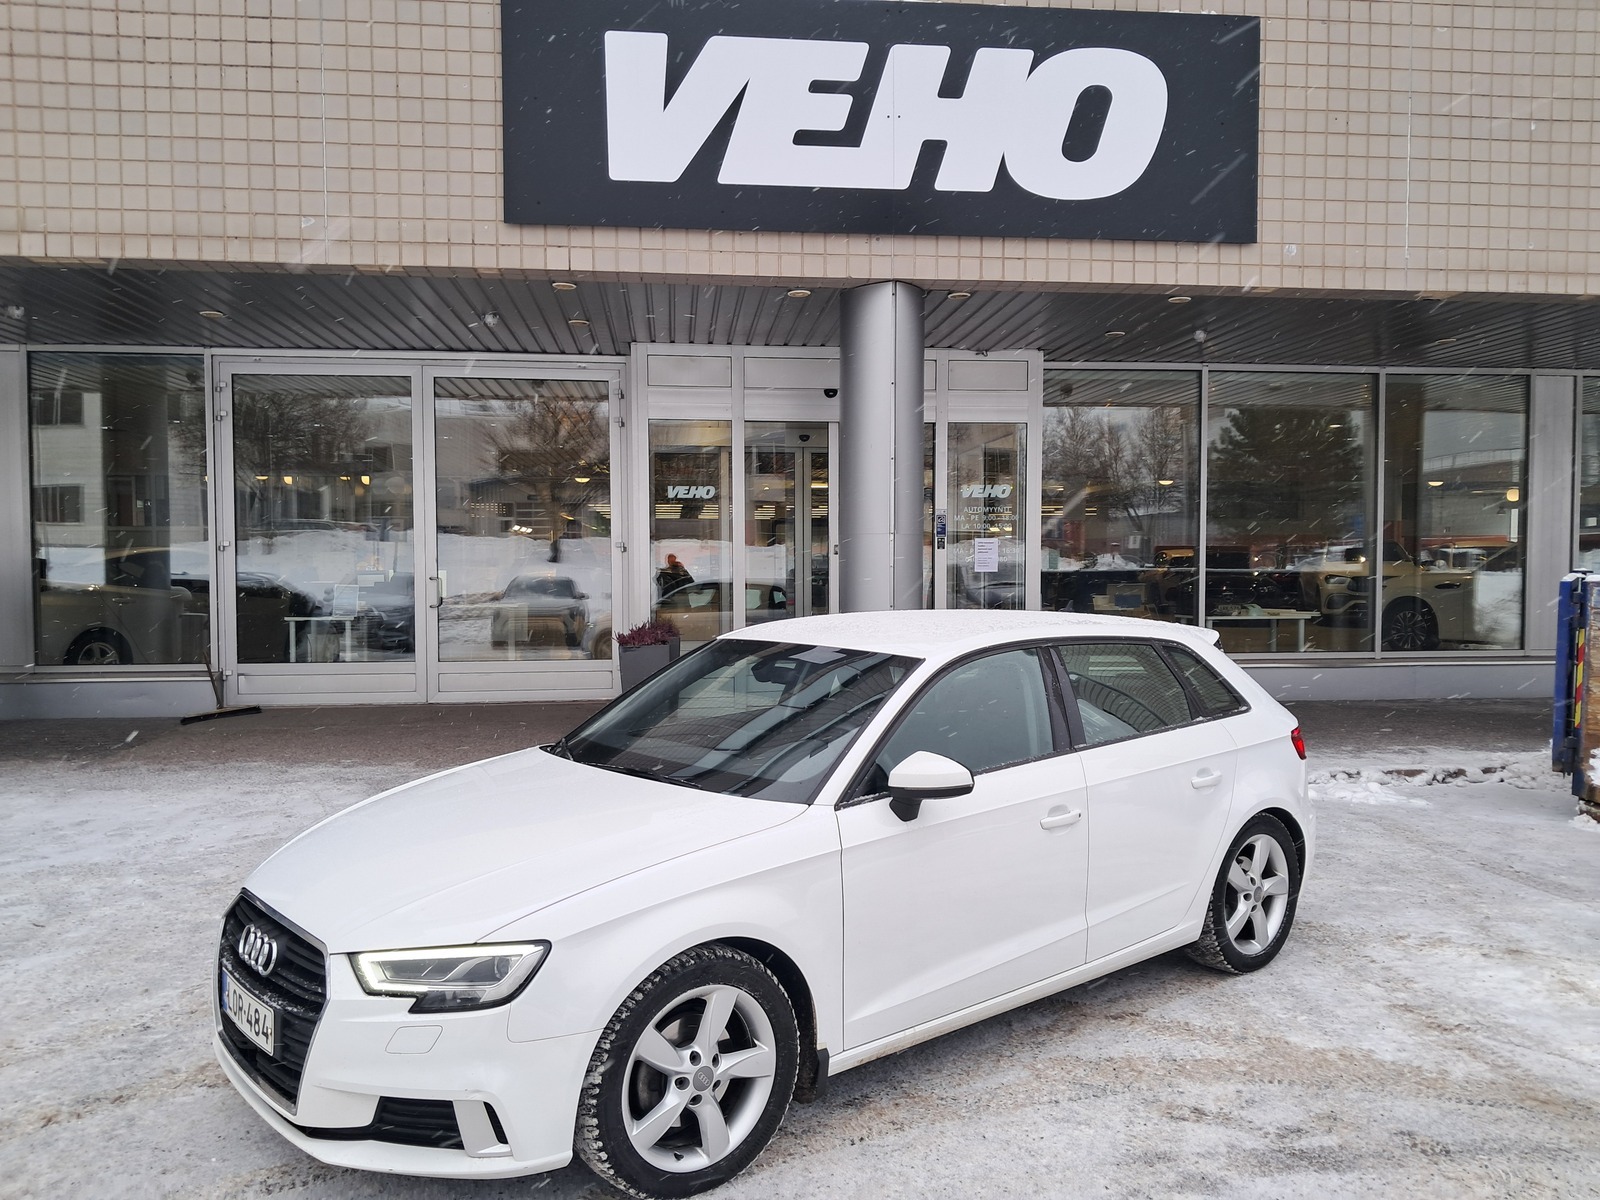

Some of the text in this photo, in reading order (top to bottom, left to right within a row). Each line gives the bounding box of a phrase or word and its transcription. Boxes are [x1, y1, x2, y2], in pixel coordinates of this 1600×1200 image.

[604, 31, 1168, 200] VEHO
[667, 485, 716, 499] VEHO
[962, 484, 1011, 498] VEHO
[227, 981, 270, 1044] LOR-484
